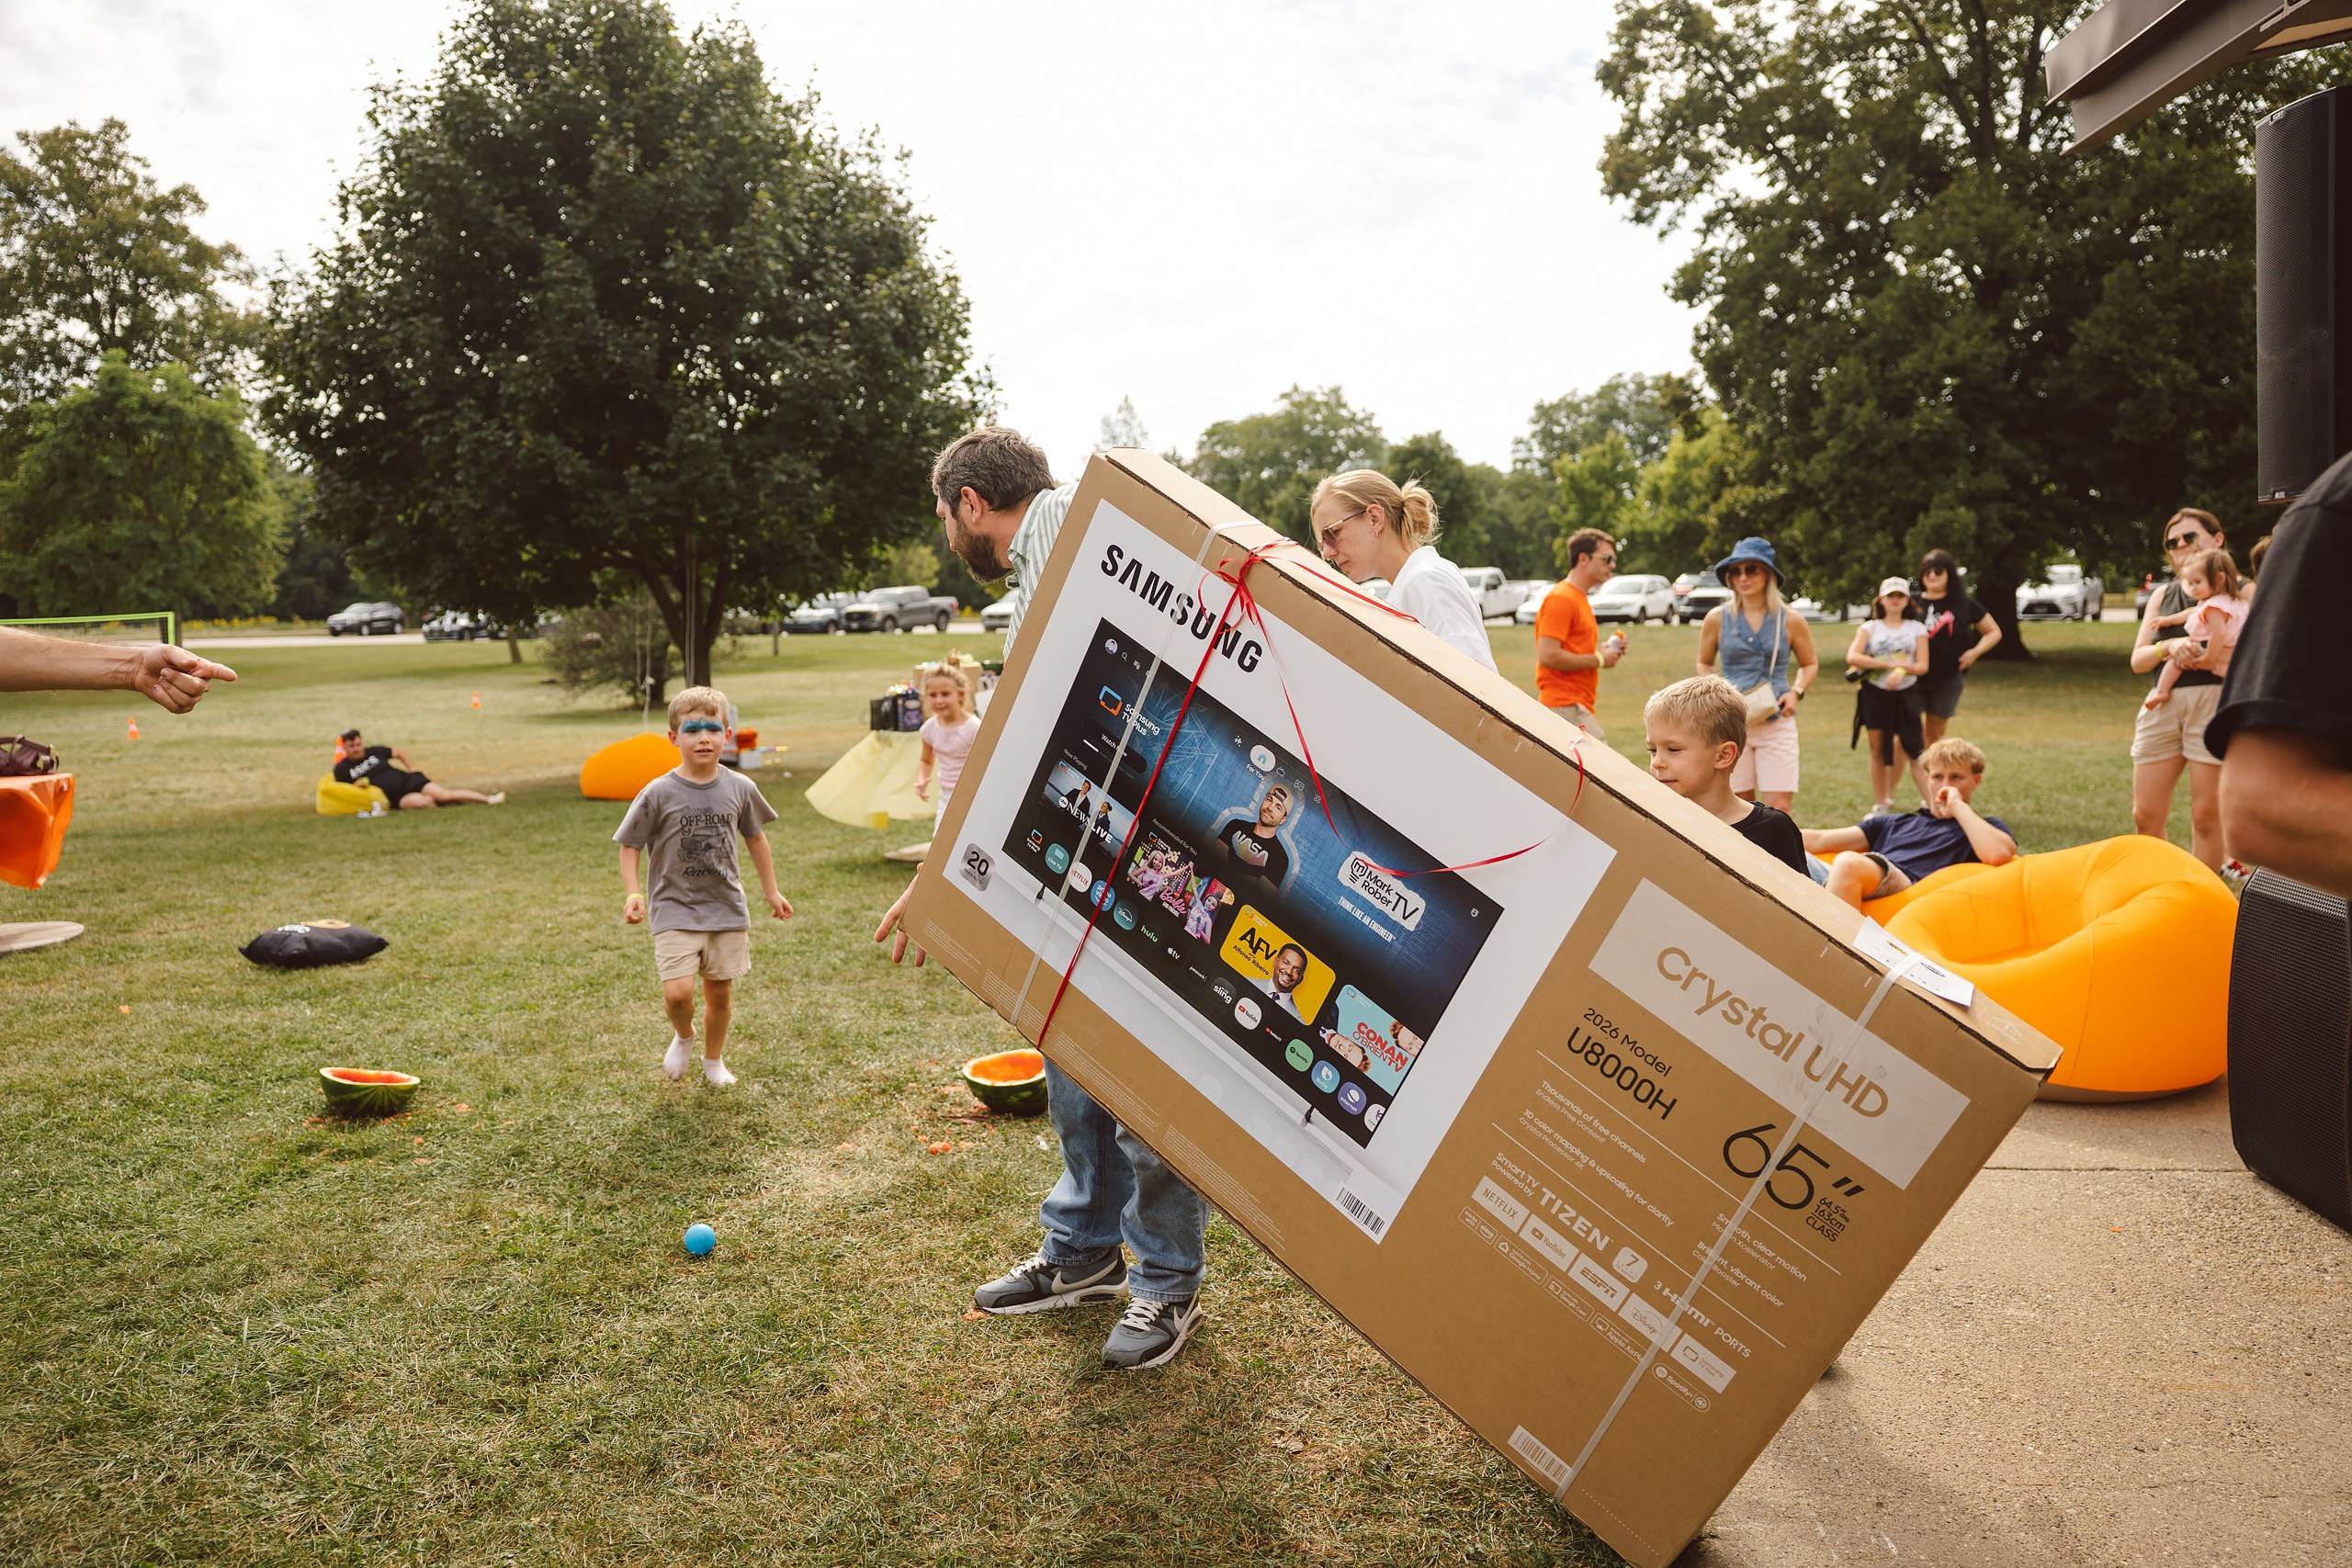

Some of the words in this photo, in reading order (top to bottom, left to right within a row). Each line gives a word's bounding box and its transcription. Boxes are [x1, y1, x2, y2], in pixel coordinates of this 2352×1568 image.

[1101, 544, 1262, 672] SAMSUNG
[1122, 712, 1132, 723] TV
[1102, 734, 1116, 750] Watch
[1072, 753, 1088, 770] Playing
[1246, 763, 1255, 773] For
[1255, 770, 1265, 781] You
[680, 813, 732, 828] OFF-ROAD
[1091, 823, 1114, 844] LIVE
[1153, 818, 1183, 845] Recommended
[1189, 845, 1198, 856] You
[1232, 830, 1269, 867] NASA
[683, 866, 728, 881] Racing
[967, 851, 989, 876] 20
[1047, 856, 1057, 866] Live
[1361, 880, 1392, 908] Rober
[1366, 871, 1394, 896] Mark
[1159, 886, 1187, 914] Barbie
[1391, 891, 1419, 920] TV
[1338, 896, 1355, 912] THINK
[1351, 907, 1364, 920] LIKE
[1362, 915, 1371, 925] AN
[1369, 920, 1394, 942] ENGINEER
[1140, 925, 1159, 942] hulu
[1238, 927, 1278, 961] AFV
[1233, 944, 1251, 962] Alfonso
[1251, 957, 1270, 976] Ribeiro
[1213, 985, 1232, 1004] sling
[1357, 1021, 1408, 1066] CONAN
[1583, 1008, 1620, 1039] 2026
[1620, 1034, 1672, 1077] Model
[1657, 946, 1805, 1063] Crystal
[1803, 1044, 1889, 1118] UHD
[1352, 1031, 1388, 1063] O'BRIEN
[1388, 1056, 1404, 1072] TV
[1567, 1026, 1678, 1121] U8000H
[1535, 1089, 1561, 1112] Endless
[1560, 1106, 1577, 1122] Free
[1542, 1080, 1583, 1116] Thousands
[1582, 1113, 1594, 1123] of
[1592, 1120, 1611, 1136] free
[1610, 1134, 1646, 1164] channels
[1519, 1117, 1543, 1138] Crystal
[1542, 1134, 1575, 1162] Processor
[1575, 1160, 1585, 1170] 4K
[1491, 1160, 1526, 1190] Powered
[1524, 1185, 1534, 1197] by
[1496, 1153, 1526, 1179] Smart
[1527, 1174, 1539, 1188] TV
[1523, 1108, 1534, 1120] 3D
[1533, 1117, 1554, 1135] color
[1554, 1133, 1589, 1164] mapping
[1589, 1159, 1597, 1168] &
[1596, 1165, 1634, 1199] upscaling
[1634, 1192, 1647, 1206] for
[1646, 1203, 1675, 1227] clarity
[1482, 1188, 1519, 1221] NETFLIX
[1815, 1204, 1846, 1232] 163cm
[1479, 1224, 1495, 1237] alexa
[1805, 1215, 1838, 1242] CLASS
[1543, 1235, 1566, 1259] YouTube
[1626, 1254, 1639, 1267] 7
[1736, 1239, 1776, 1270] Xcelerator
[1752, 1239, 1776, 1258] clear
[1775, 1256, 1807, 1281] motion
[1509, 1252, 1527, 1269] Google
[1525, 1267, 1541, 1280] Home
[1712, 1264, 1741, 1288] Booster
[1580, 1267, 1617, 1299] ESPN
[1730, 1265, 1761, 1292] vibrant
[1760, 1289, 1784, 1307] color
[1560, 1293, 1577, 1309] Google
[1576, 1305, 1587, 1317] Cast
[1654, 1280, 1663, 1291] 3
[1714, 1326, 1752, 1358] PORTS
[1607, 1331, 1625, 1348] Apple
[1700, 1358, 1724, 1379] Samsung
[1704, 1368, 1715, 1378] Plus
